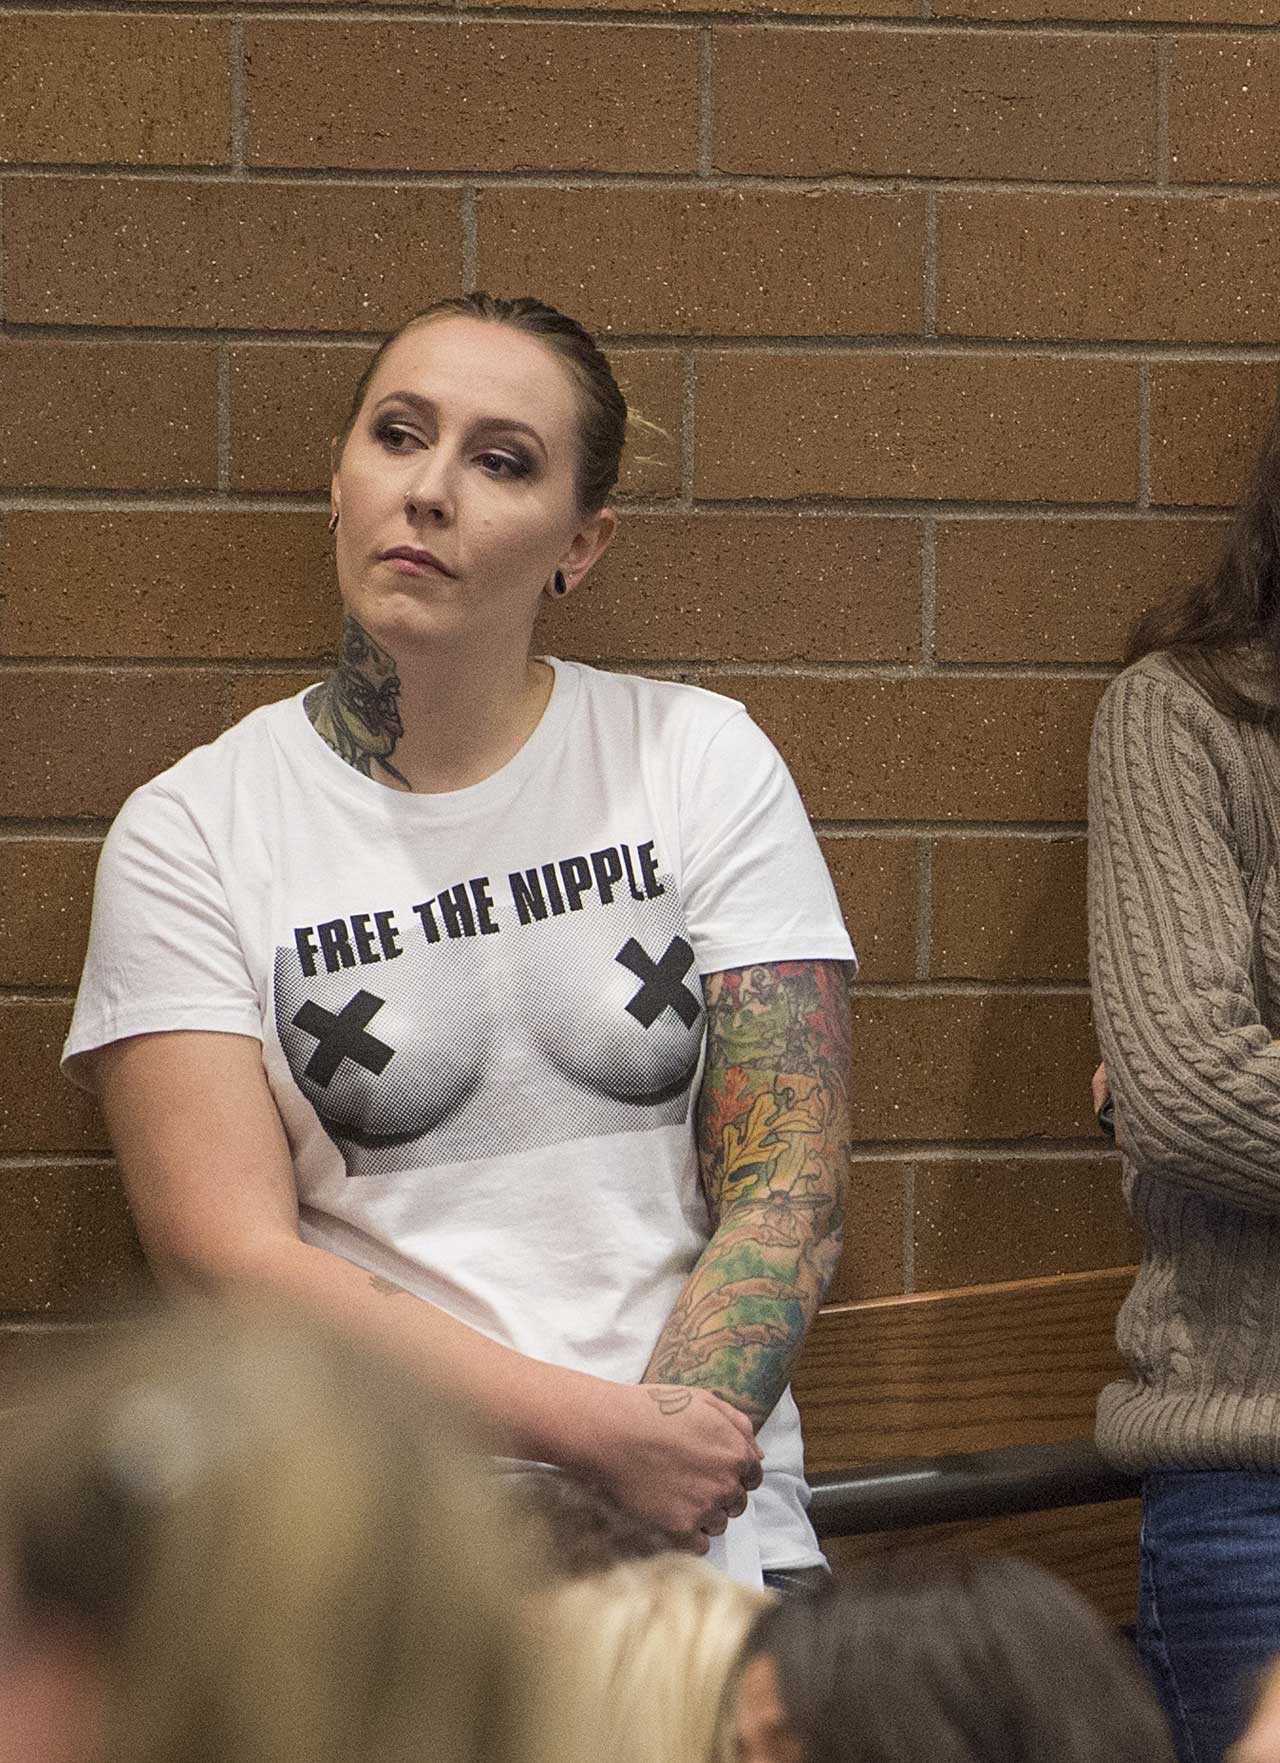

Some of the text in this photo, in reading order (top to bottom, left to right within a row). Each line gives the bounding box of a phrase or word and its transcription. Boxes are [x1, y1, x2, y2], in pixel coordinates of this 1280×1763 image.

[294, 840, 665, 977] FREE THE NIPPLE
